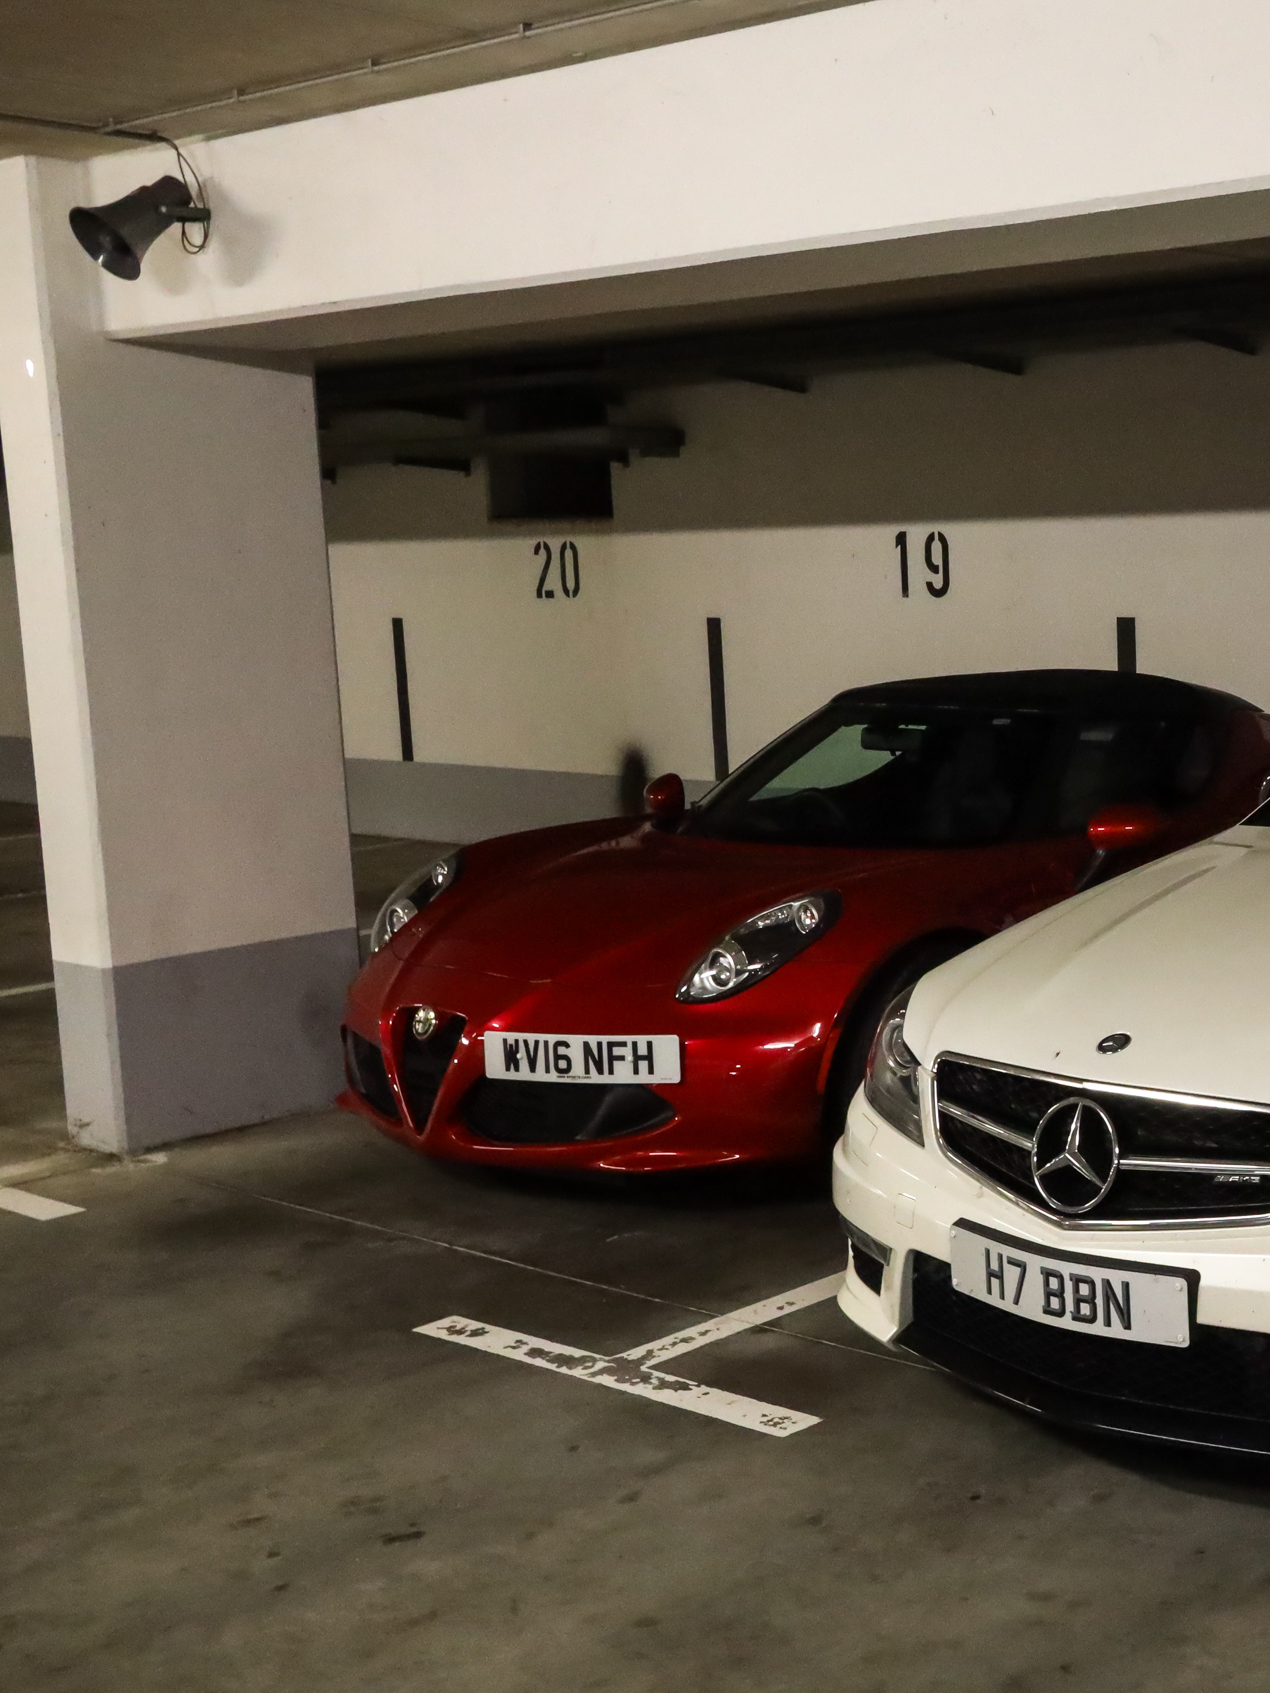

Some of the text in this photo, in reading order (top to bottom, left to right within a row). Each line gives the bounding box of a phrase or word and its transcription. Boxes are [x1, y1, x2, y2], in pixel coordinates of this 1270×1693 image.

[534, 540, 580, 598] 20
[895, 531, 951, 598] 19
[503, 1038, 655, 1076] WV16 NFH
[984, 1247, 1132, 1331] H7 BBN
